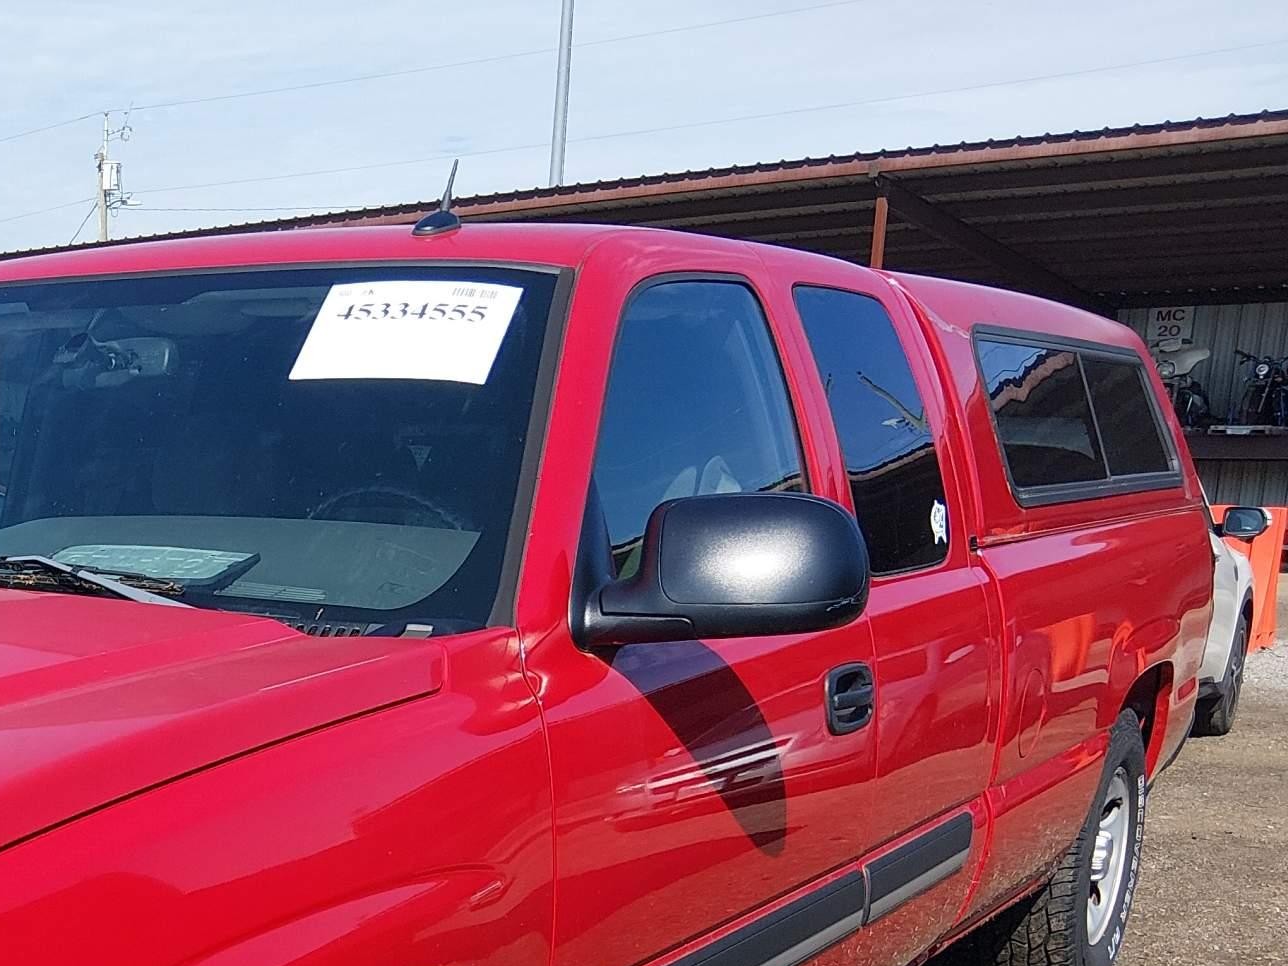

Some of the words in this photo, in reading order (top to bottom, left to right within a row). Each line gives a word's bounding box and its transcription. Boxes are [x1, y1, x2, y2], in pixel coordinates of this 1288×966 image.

[337, 302, 488, 321] 45334555
[1156, 309, 1186, 322] MC
[1158, 325, 1181, 336] 20
